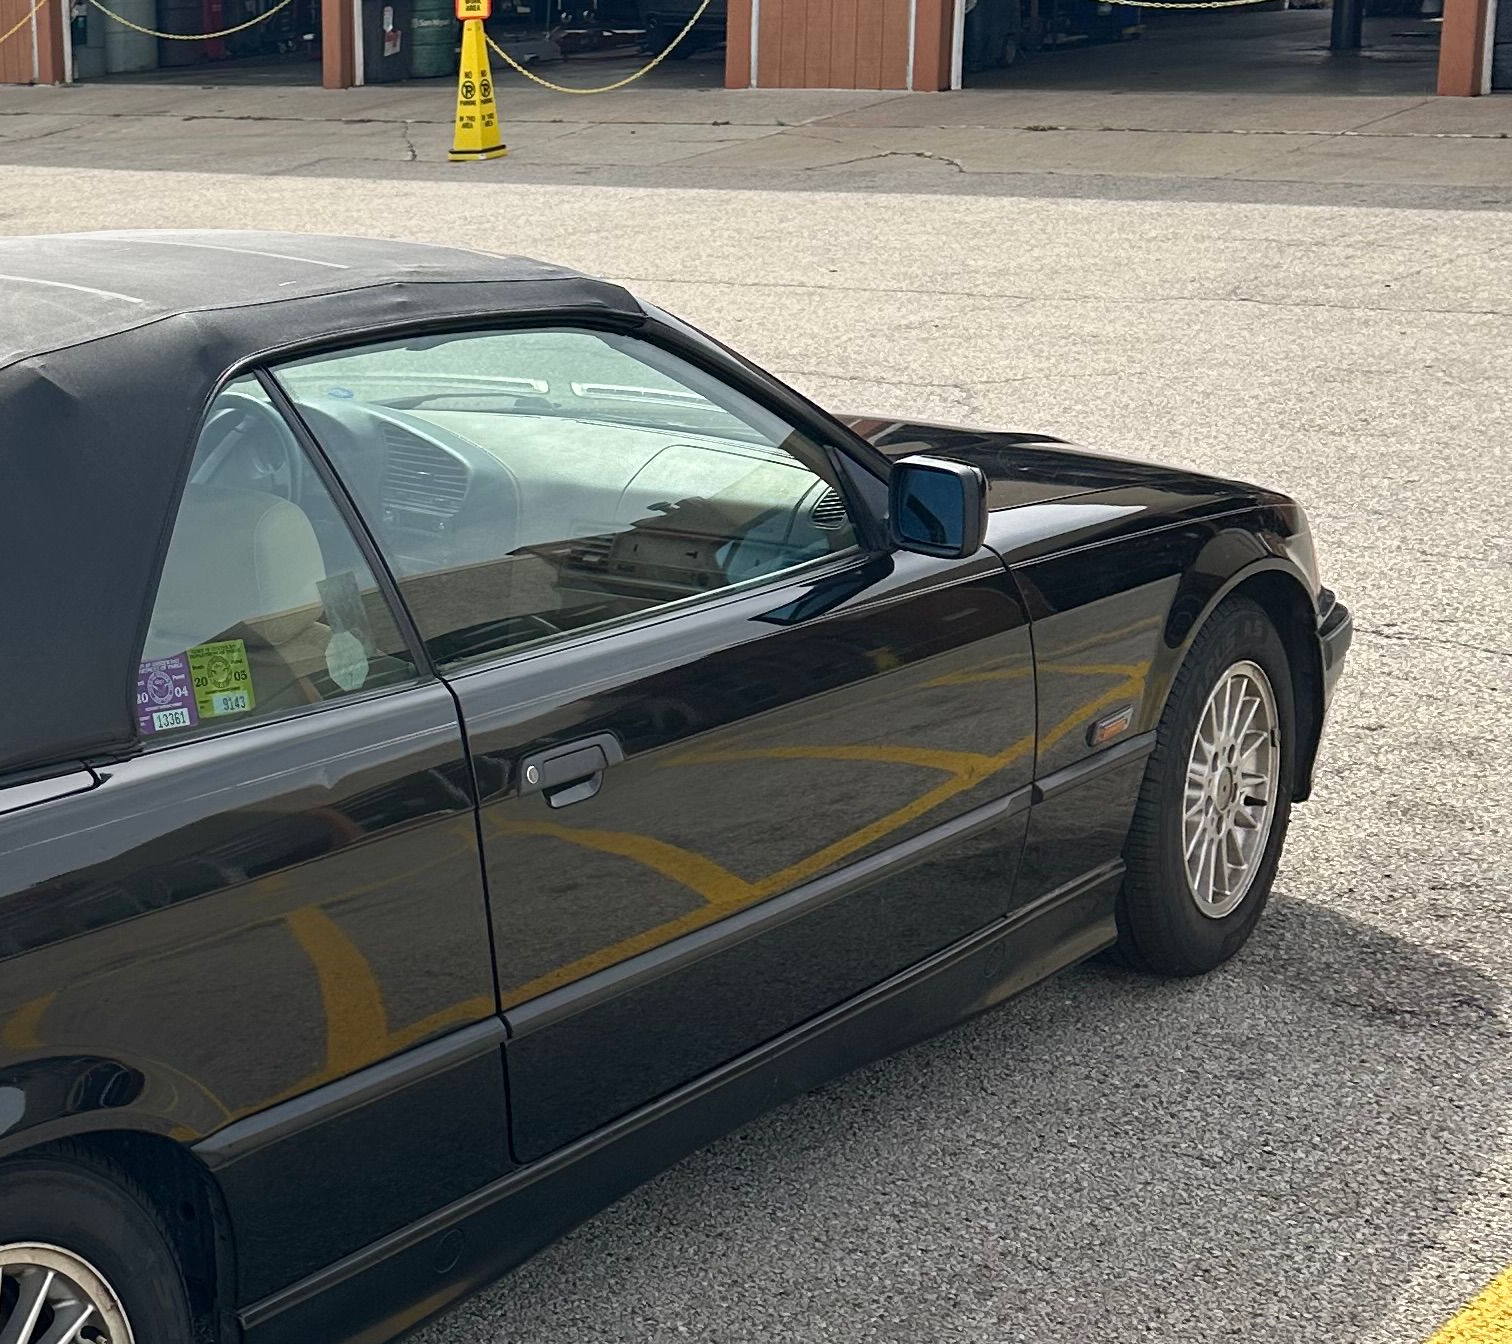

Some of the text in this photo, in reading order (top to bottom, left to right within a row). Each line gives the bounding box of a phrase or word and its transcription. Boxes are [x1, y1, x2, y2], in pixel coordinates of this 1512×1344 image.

[193, 676, 208, 687] 20
[174, 686, 188, 698] 04
[222, 695, 246, 711] 9143
[156, 711, 187, 729] 13361
